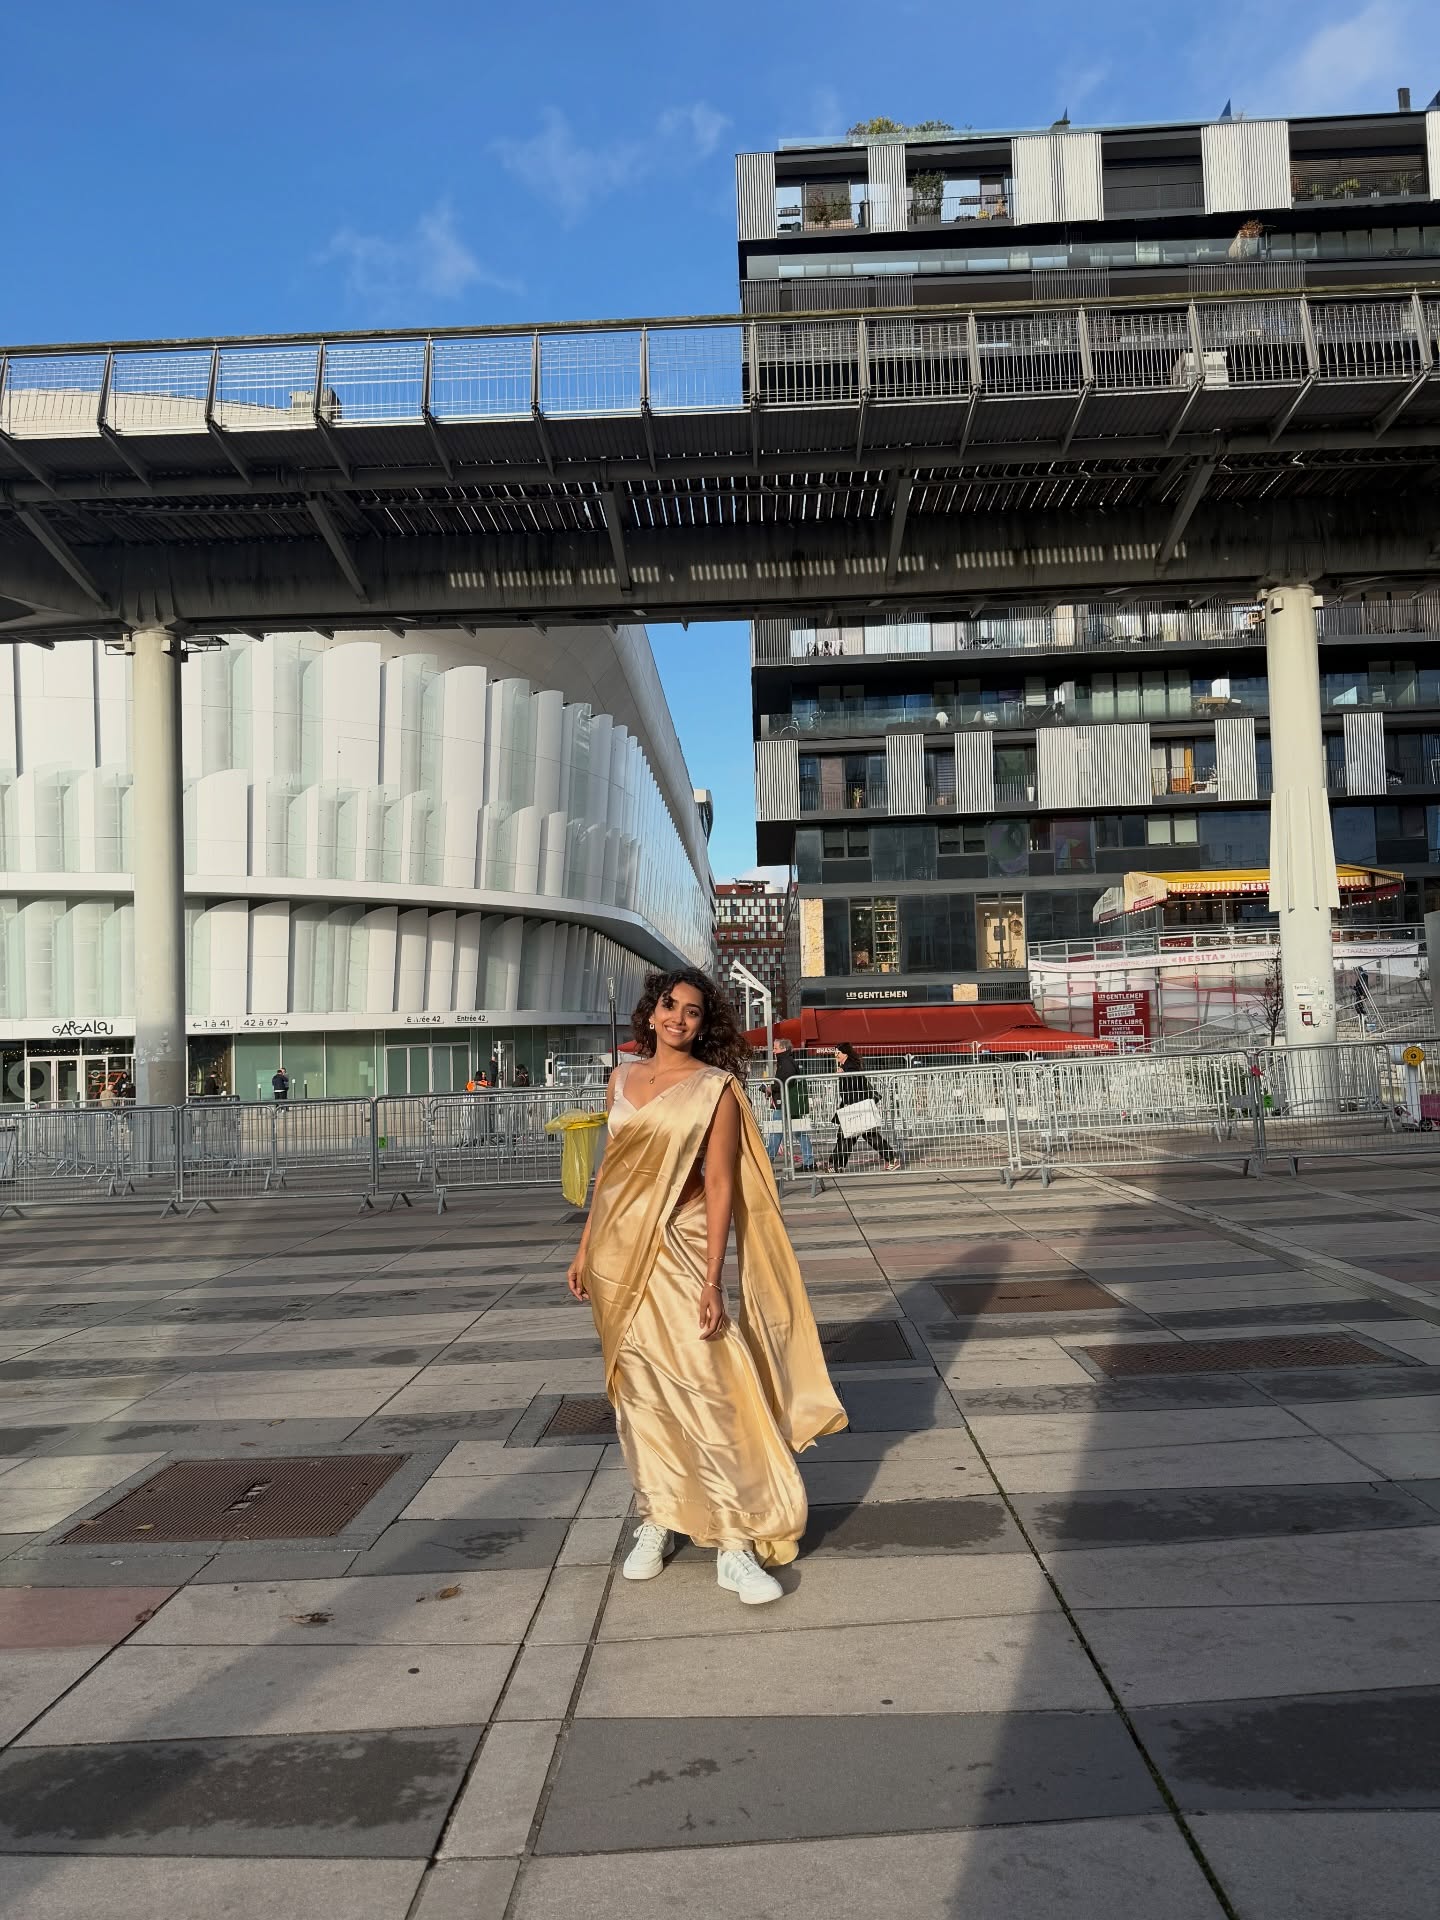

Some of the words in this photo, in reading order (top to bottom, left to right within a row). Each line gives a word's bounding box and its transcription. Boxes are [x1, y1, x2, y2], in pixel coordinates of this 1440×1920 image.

[1178, 954, 1219, 964] MESITA
[857, 990, 908, 999] GENTLEMEN
[1106, 992, 1144, 1000] GENTLEMEN
[243, 1019, 256, 1027] 42
[258, 1018, 264, 1027] à
[267, 1018, 279, 1027] 67
[432, 1015, 441, 1023] 42
[478, 1014, 486, 1022] 42
[52, 1019, 113, 1036] GARGALOU
[211, 1019, 217, 1028] à
[219, 1019, 230, 1028] 41
